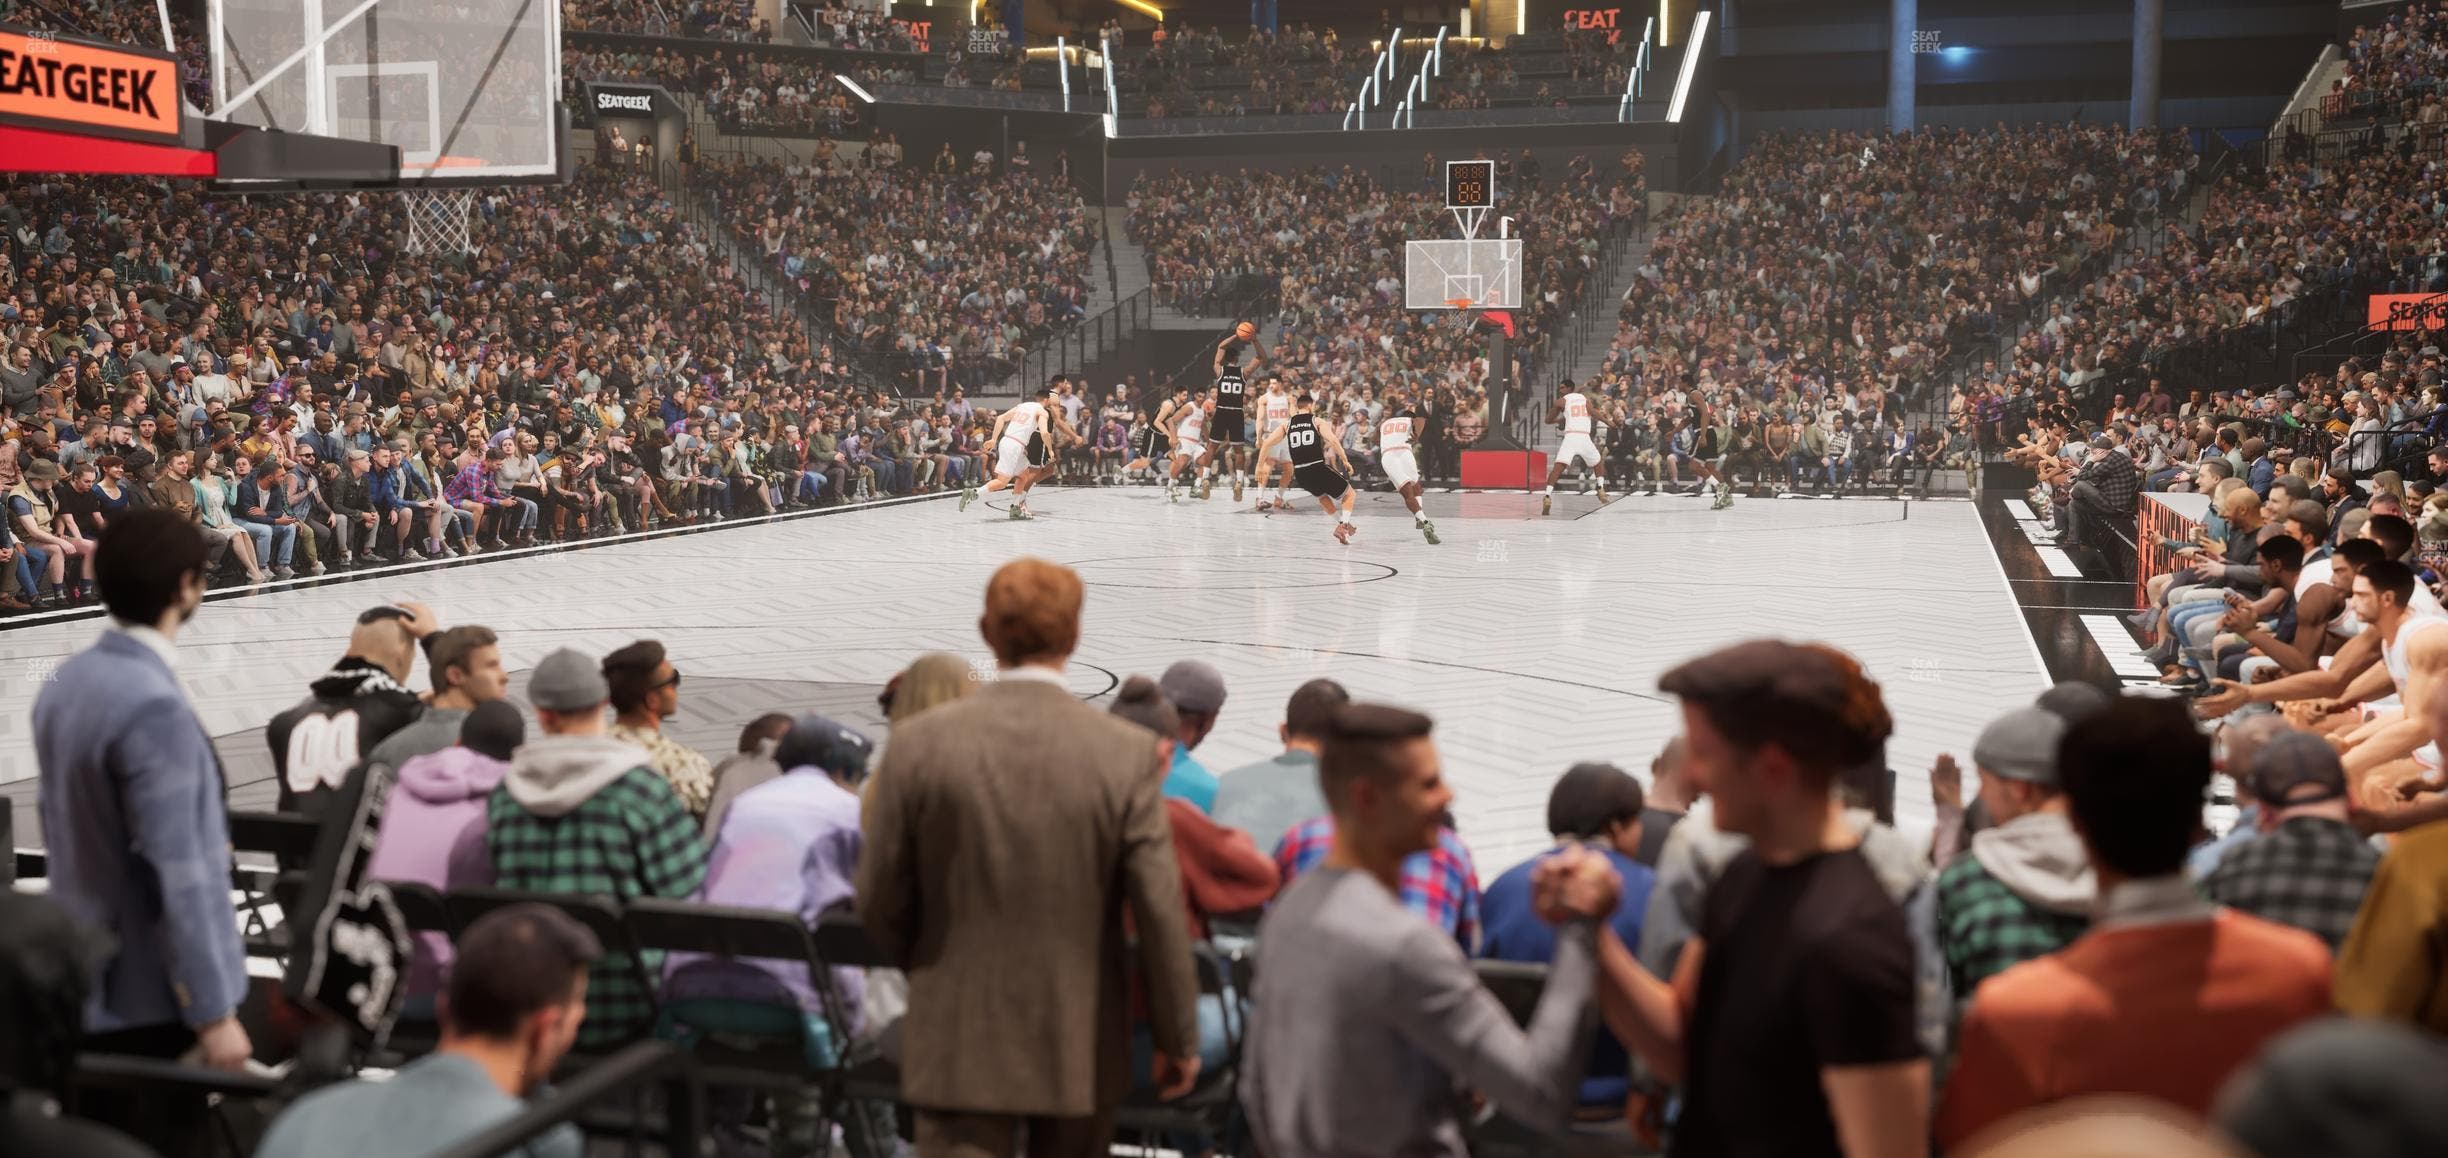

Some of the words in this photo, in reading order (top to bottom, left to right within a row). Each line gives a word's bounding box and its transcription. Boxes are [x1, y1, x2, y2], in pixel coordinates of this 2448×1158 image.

[598, 93, 652, 111] SEATGEEK
[1221, 382, 1243, 394] 00
[1290, 430, 1315, 448] 00
[287, 708, 359, 792] 00
